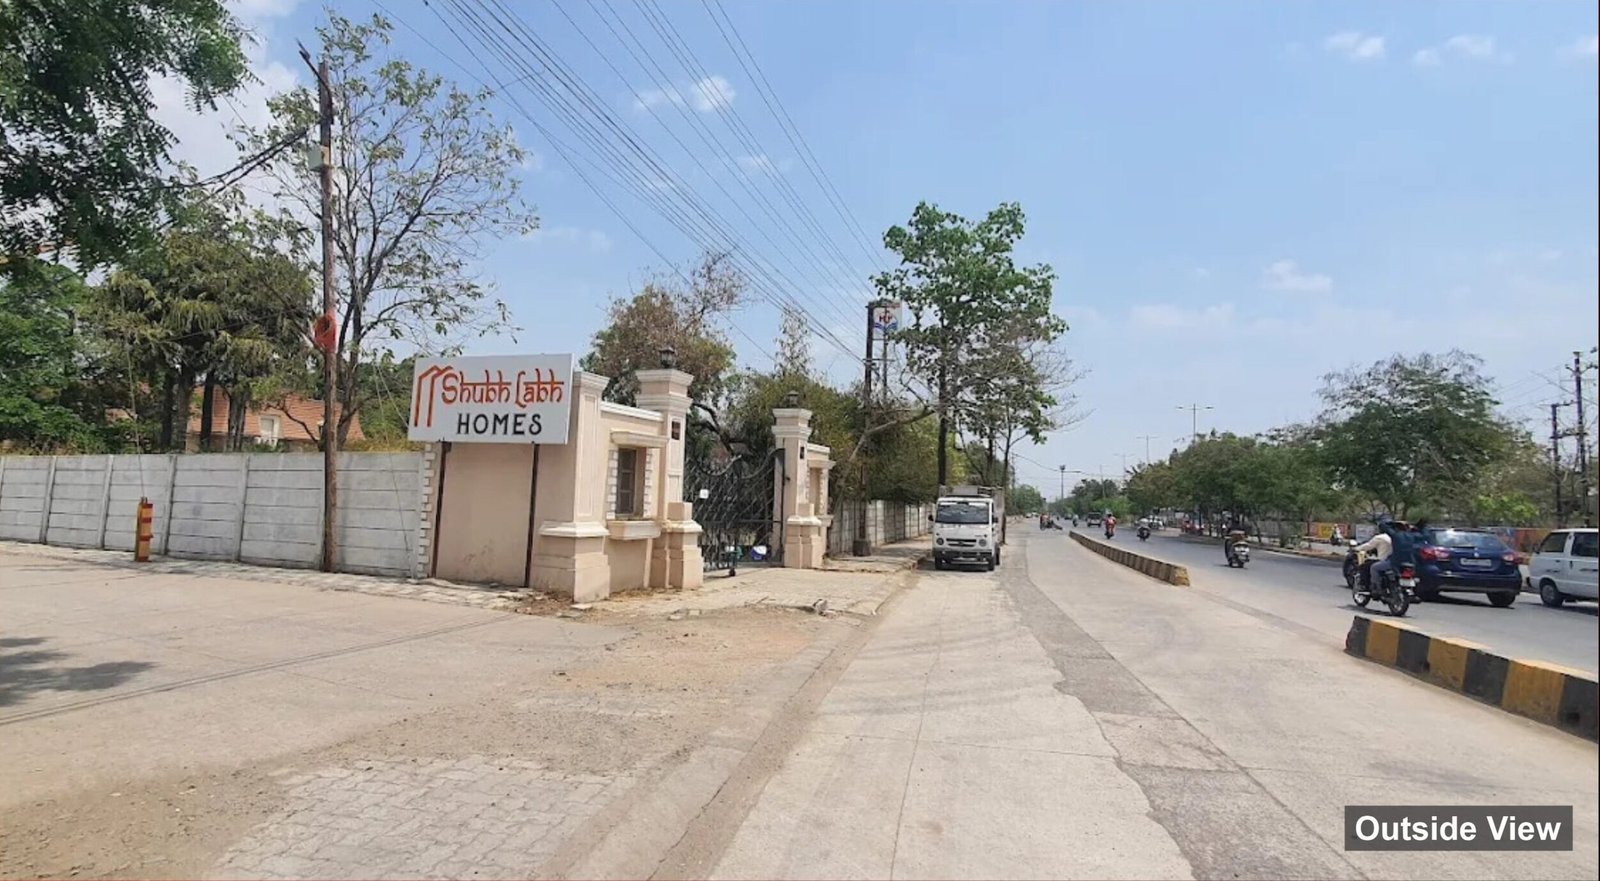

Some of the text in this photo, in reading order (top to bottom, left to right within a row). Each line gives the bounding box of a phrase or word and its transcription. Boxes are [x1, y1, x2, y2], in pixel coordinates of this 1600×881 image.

[441, 368, 565, 408] Shubh Labh
[456, 412, 543, 436] HOMES
